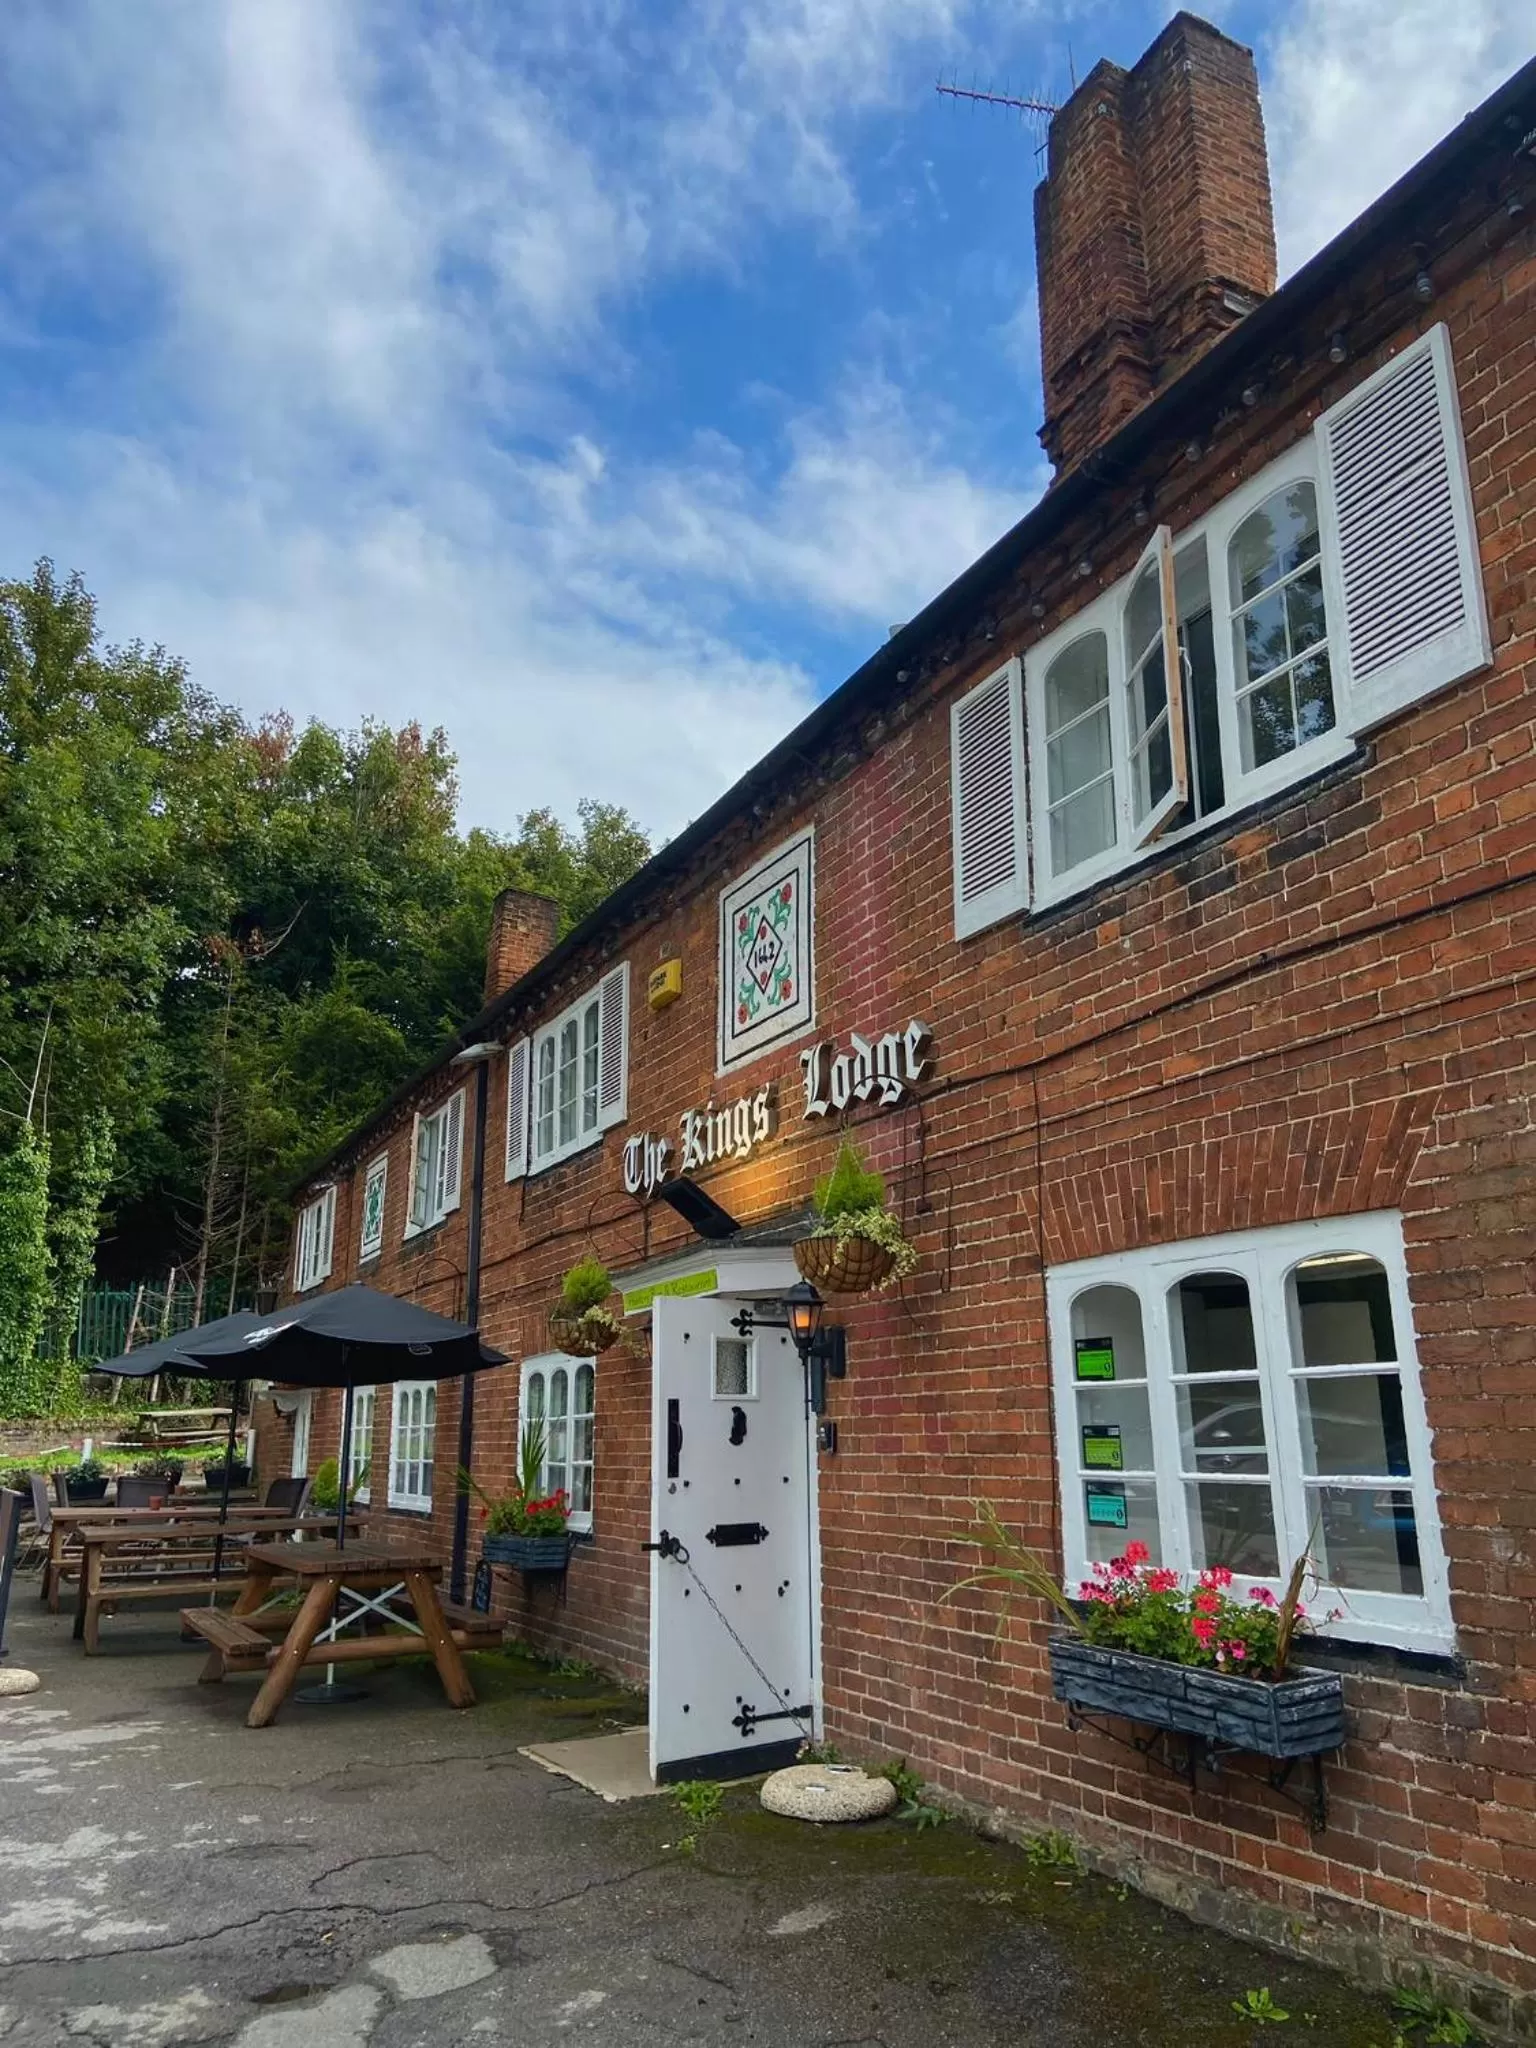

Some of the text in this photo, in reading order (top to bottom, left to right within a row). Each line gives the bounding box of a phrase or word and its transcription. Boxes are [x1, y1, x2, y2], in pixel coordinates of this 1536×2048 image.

[754, 941, 775, 969] 1642
[623, 1131, 671, 1199] The
[800, 1019, 932, 1120] Lodge
